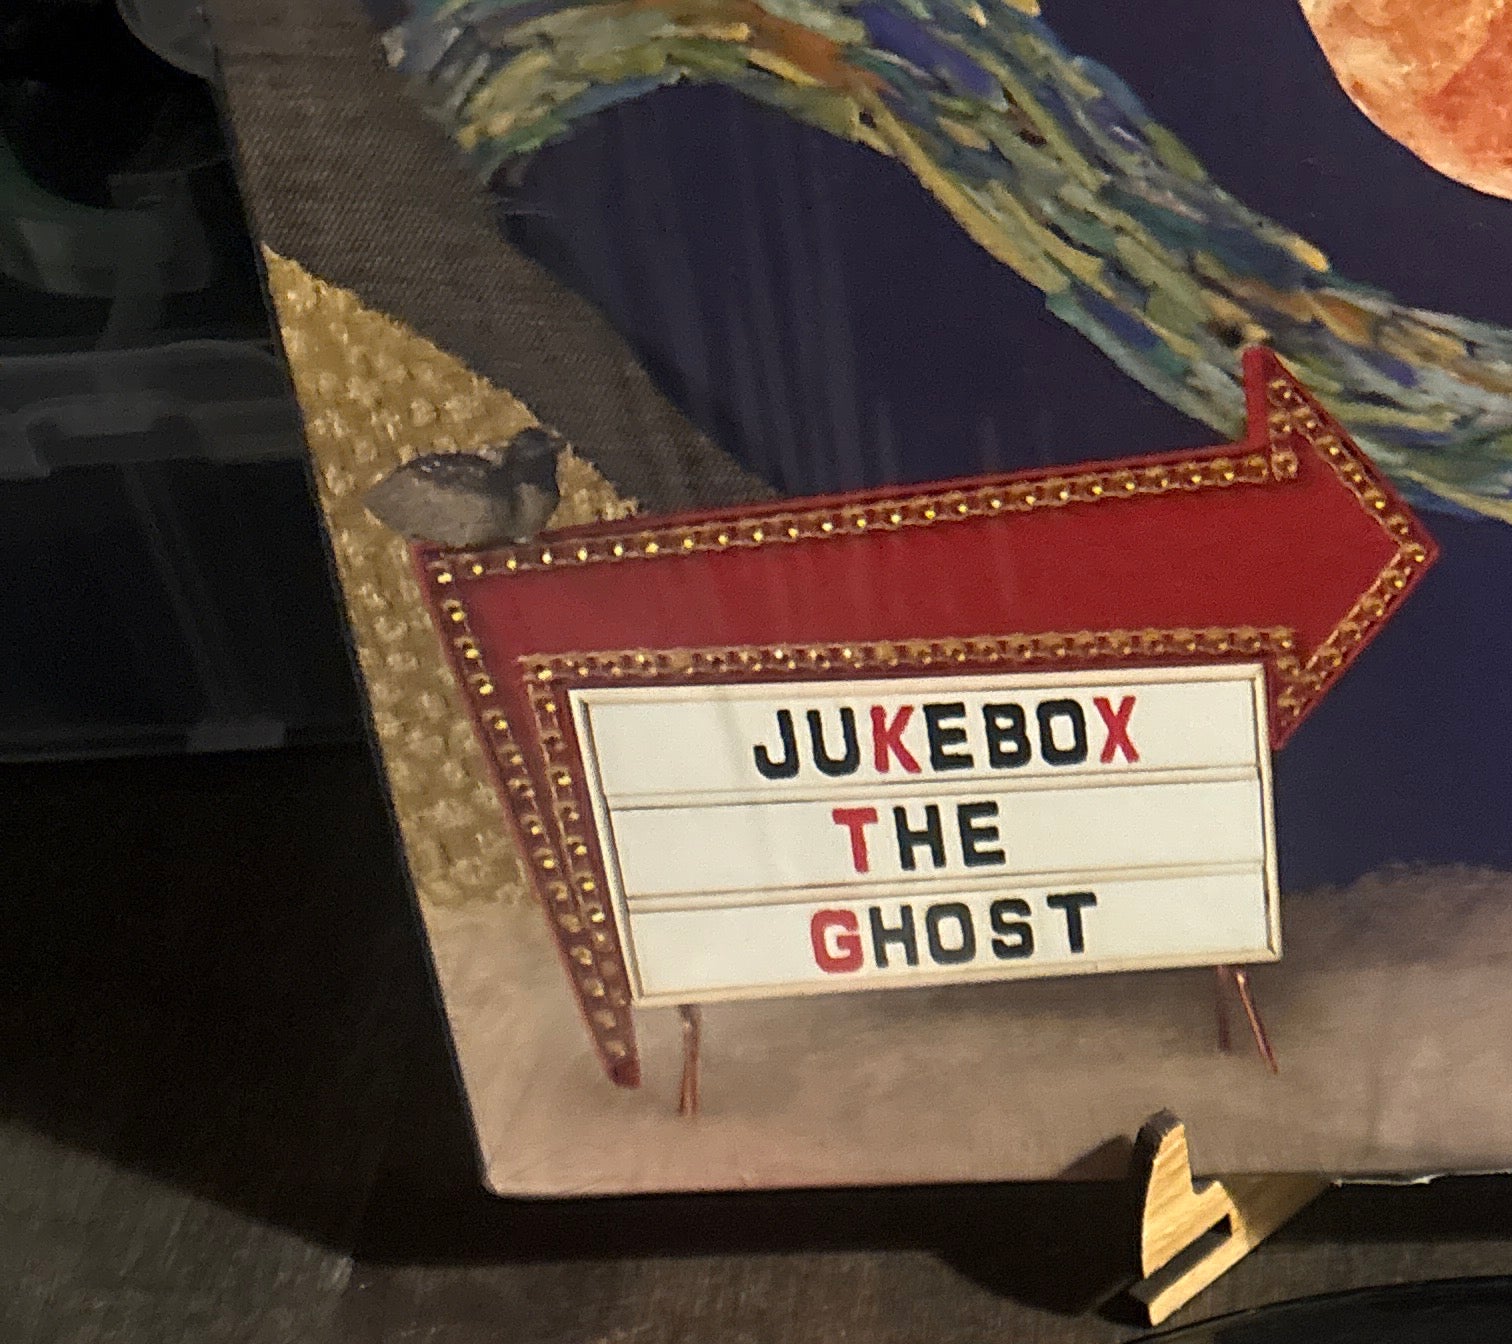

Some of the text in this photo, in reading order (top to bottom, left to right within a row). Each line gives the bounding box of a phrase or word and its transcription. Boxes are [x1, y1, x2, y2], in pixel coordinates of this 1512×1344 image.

[753, 695, 1140, 781] JUKEBOX
[832, 800, 1007, 873] THE
[809, 891, 1097, 974] GHOST
